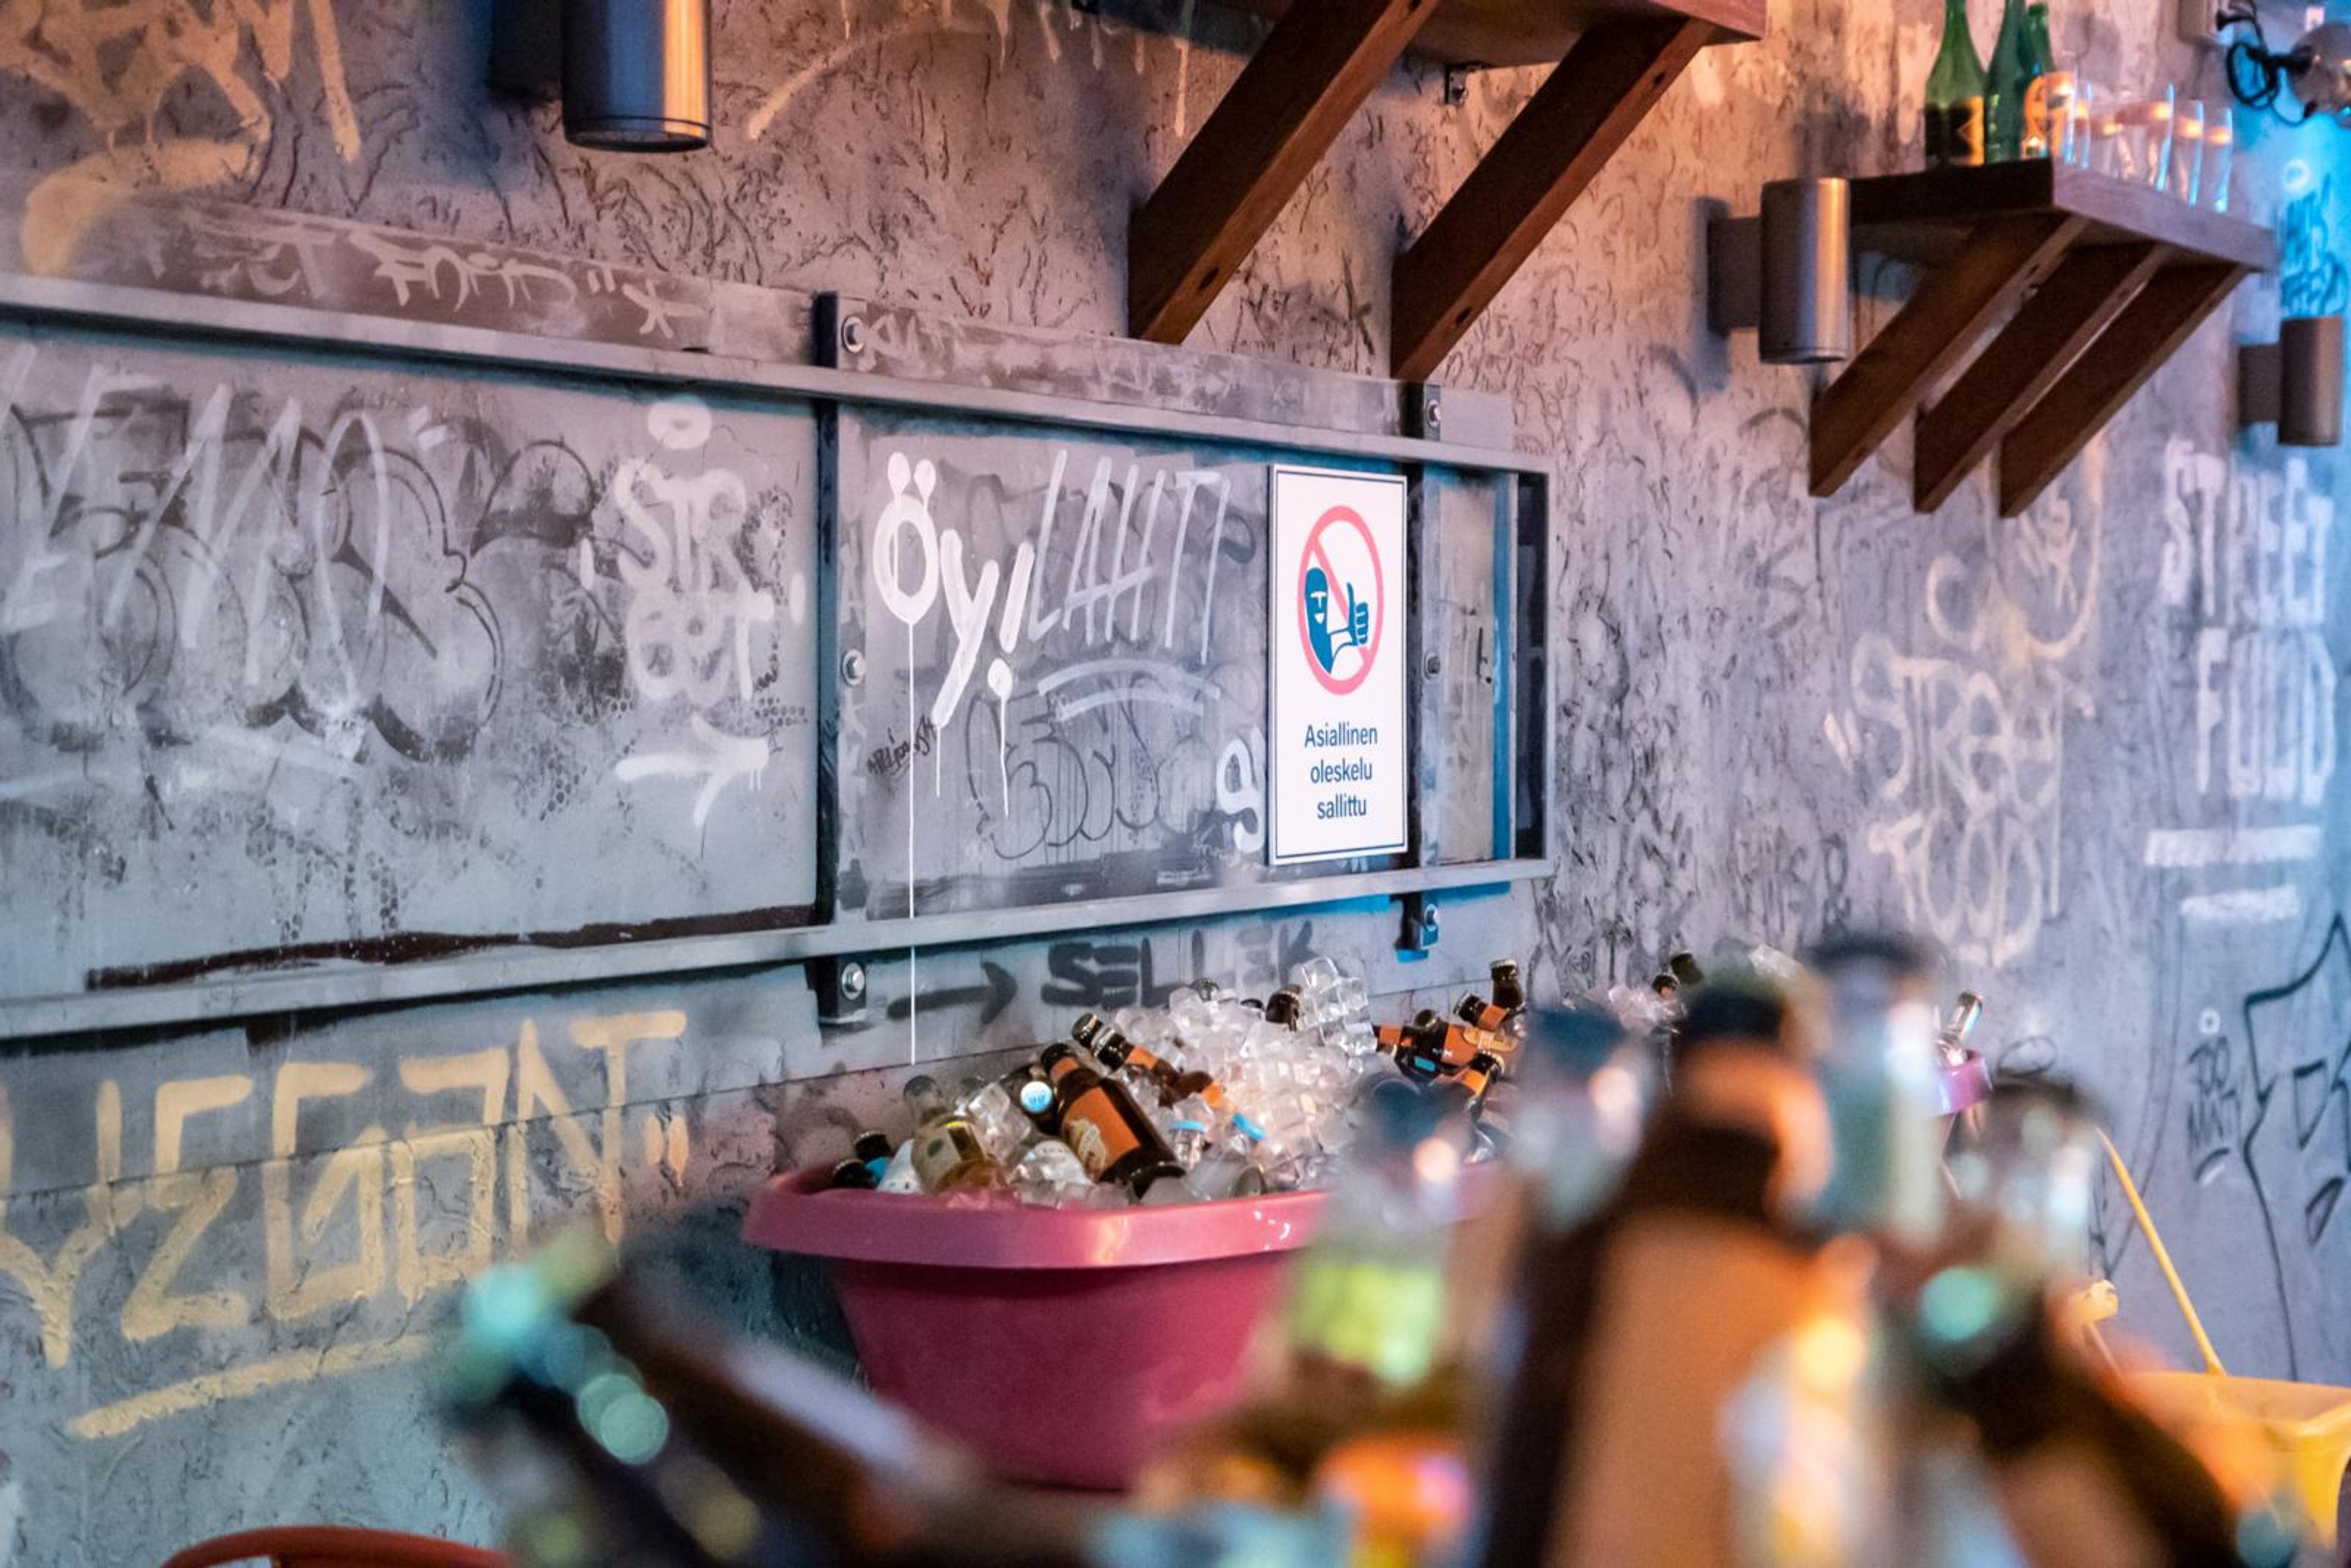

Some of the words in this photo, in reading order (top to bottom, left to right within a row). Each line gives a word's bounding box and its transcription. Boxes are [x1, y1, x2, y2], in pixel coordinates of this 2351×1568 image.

[1305, 721, 1378, 748] Asiallinen
[1310, 756, 1373, 784] oleskelu
[1317, 793, 1367, 820] sallittu
